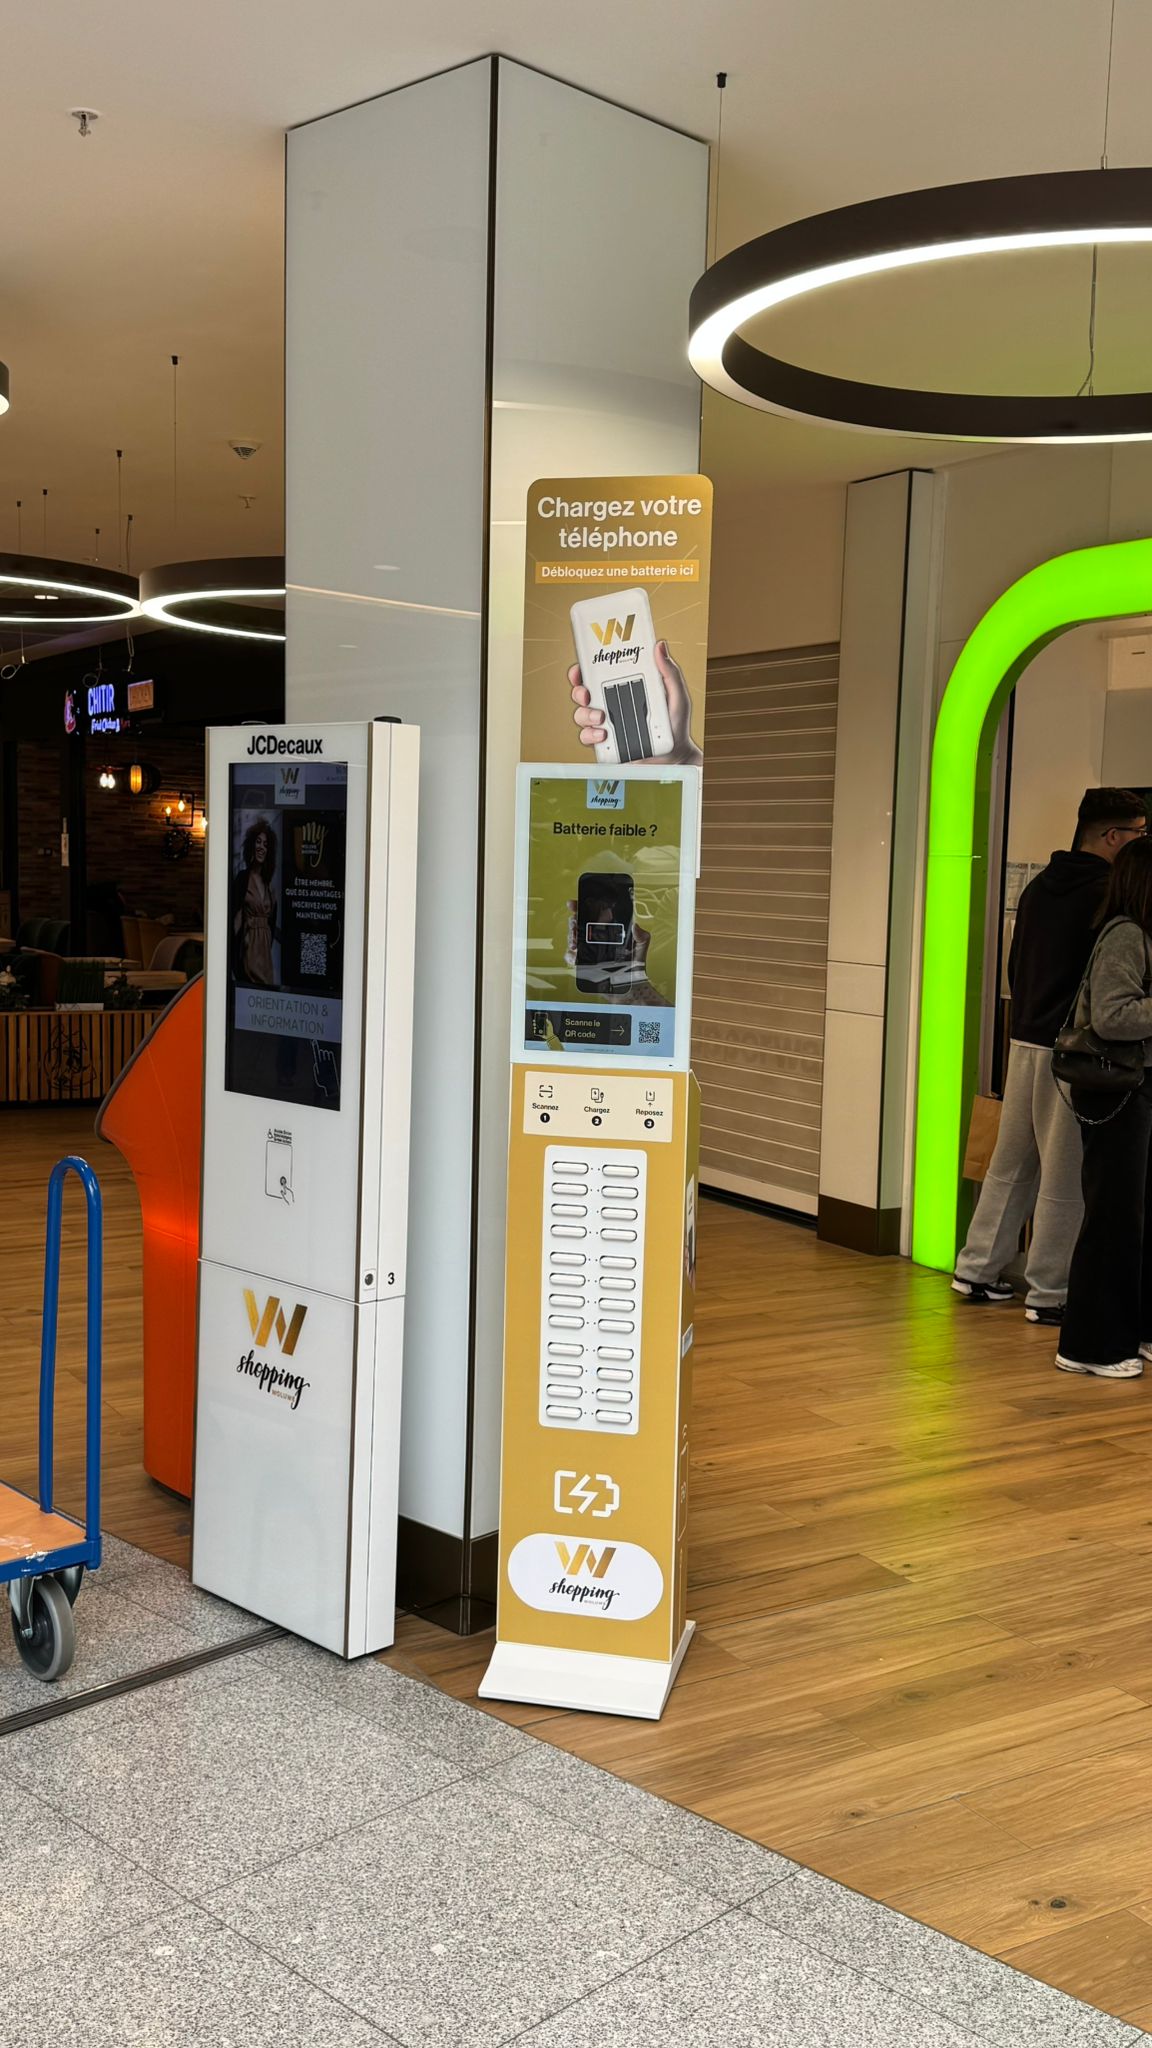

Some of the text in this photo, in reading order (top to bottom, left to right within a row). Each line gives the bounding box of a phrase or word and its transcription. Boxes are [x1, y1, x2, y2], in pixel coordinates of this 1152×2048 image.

[537, 494, 702, 521] Chargez votre
[559, 525, 678, 552] téléphone
[541, 565, 694, 579] Débloquez une batterie ici
[592, 645, 645, 665] shopping
[87, 683, 115, 716] CHITIR
[247, 735, 323, 755] JCDecaux
[553, 821, 658, 837] Batterie faible ?
[247, 994, 328, 1017] ORIENTATION &
[250, 1013, 324, 1035] INFORMATION
[565, 1017, 601, 1028] Scanne le
[565, 1030, 596, 1039] QR code
[532, 1102, 664, 1117] Scannez Chargez Reposez
[387, 1272, 395, 1285] 3
[236, 1349, 310, 1410] shopping
[549, 1578, 620, 1610] shopping
